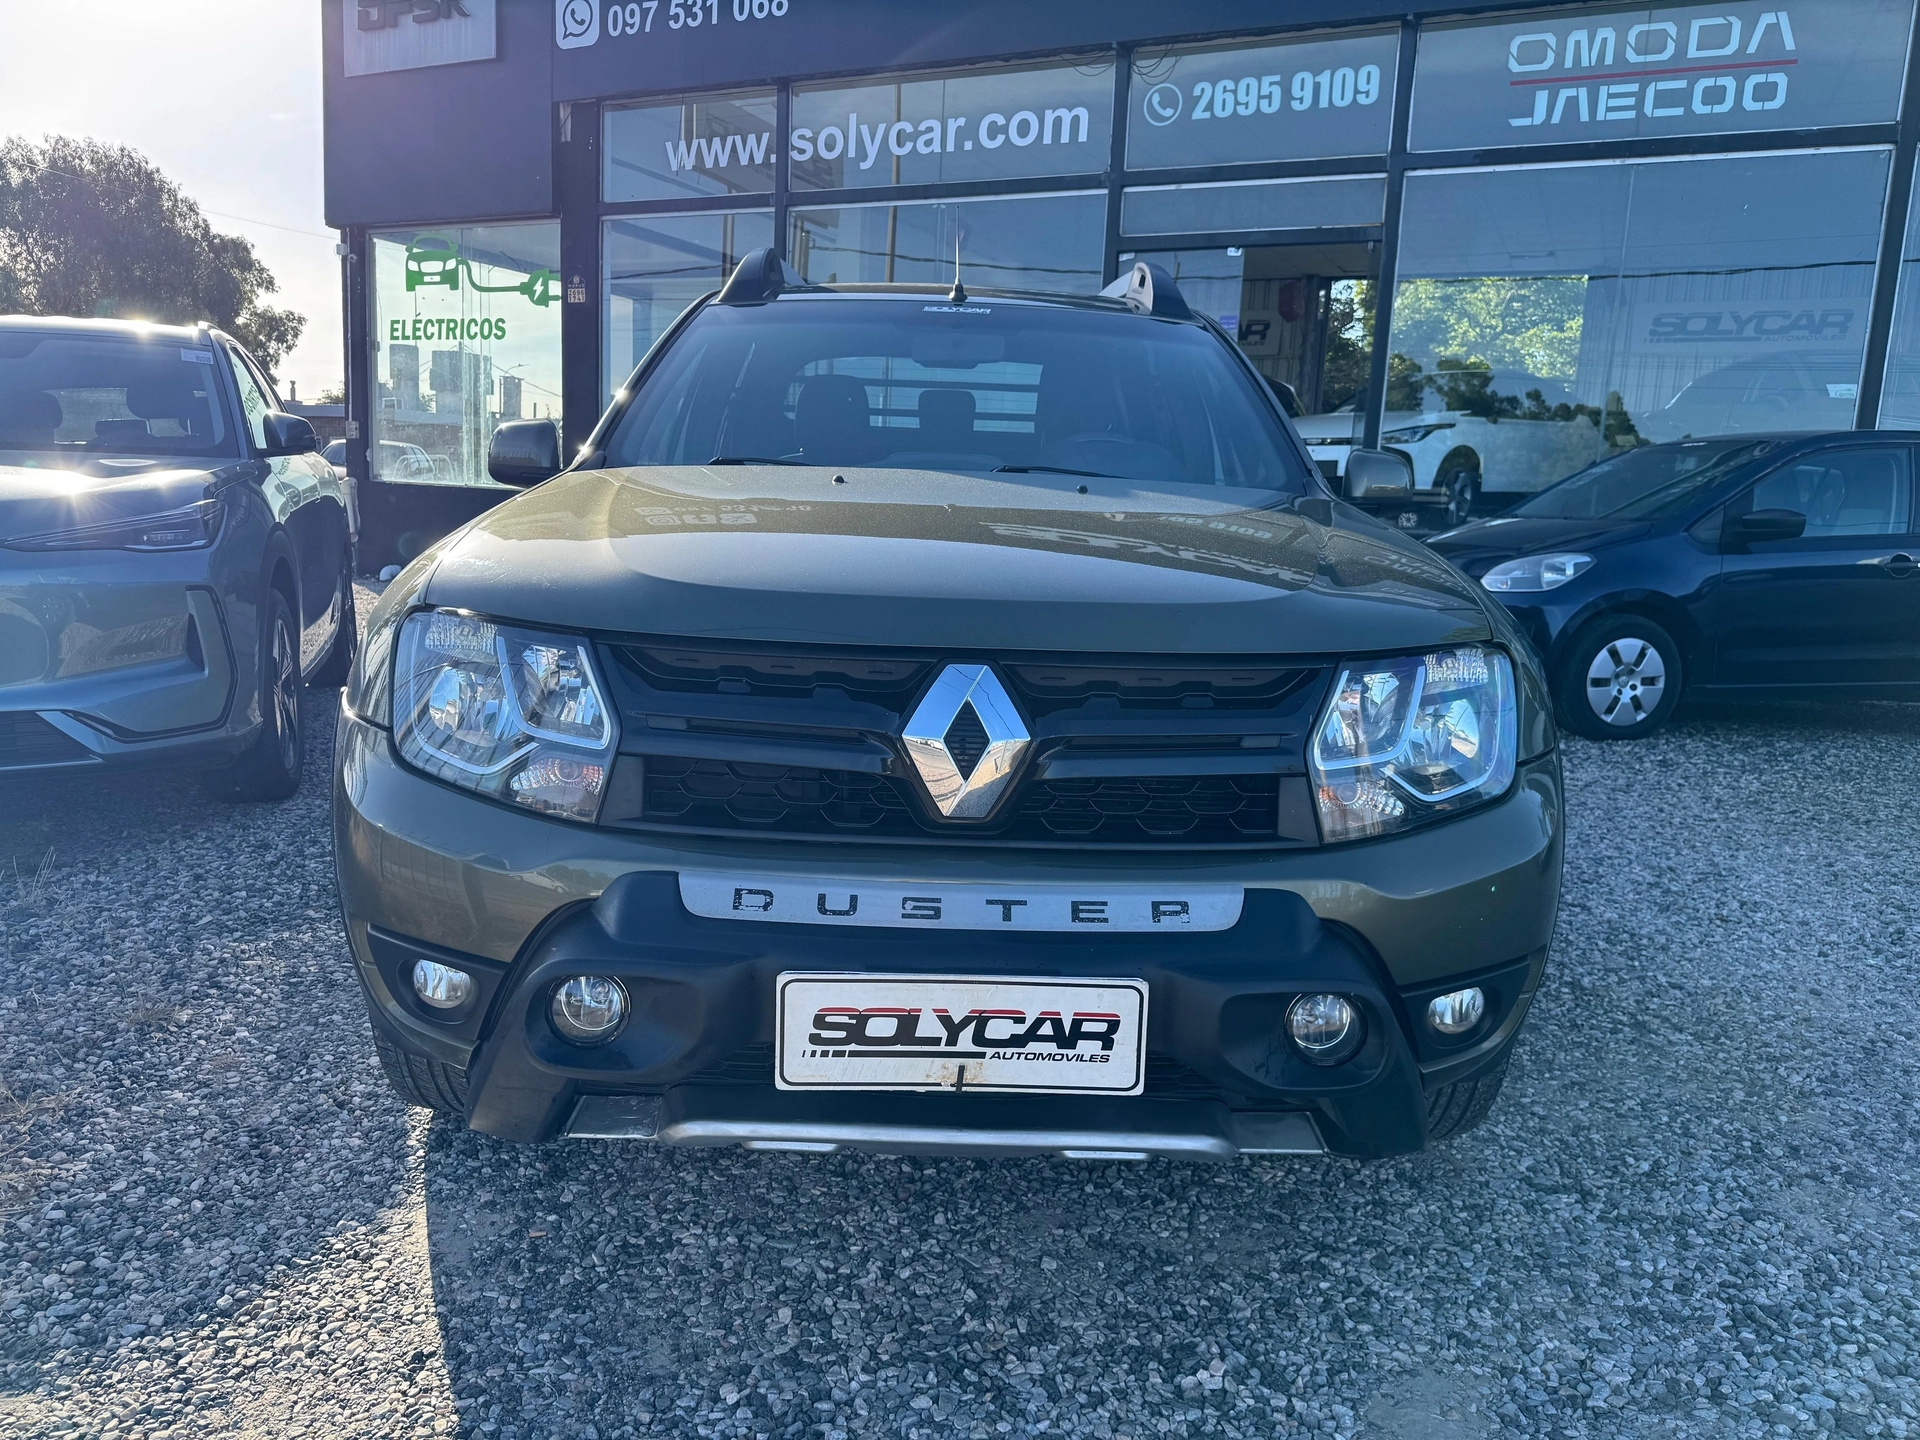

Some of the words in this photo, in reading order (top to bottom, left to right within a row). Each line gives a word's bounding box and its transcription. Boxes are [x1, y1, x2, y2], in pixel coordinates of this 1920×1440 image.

[607, 1, 659, 37] 097
[668, 0, 719, 29] 531
[1507, 11, 1797, 73] OMODA
[1191, 75, 1282, 120] 2695
[1290, 64, 1381, 111] 9109
[1507, 72, 1789, 127] JAECOO
[1648, 309, 1854, 337] SOLYCAR
[1761, 333, 1847, 342] AUTOMOVILES
[732, 888, 1191, 925] DUSTER
[808, 1006, 1121, 1052] SOLYCAR
[988, 1051, 1111, 1064] AUTOMOVILES
